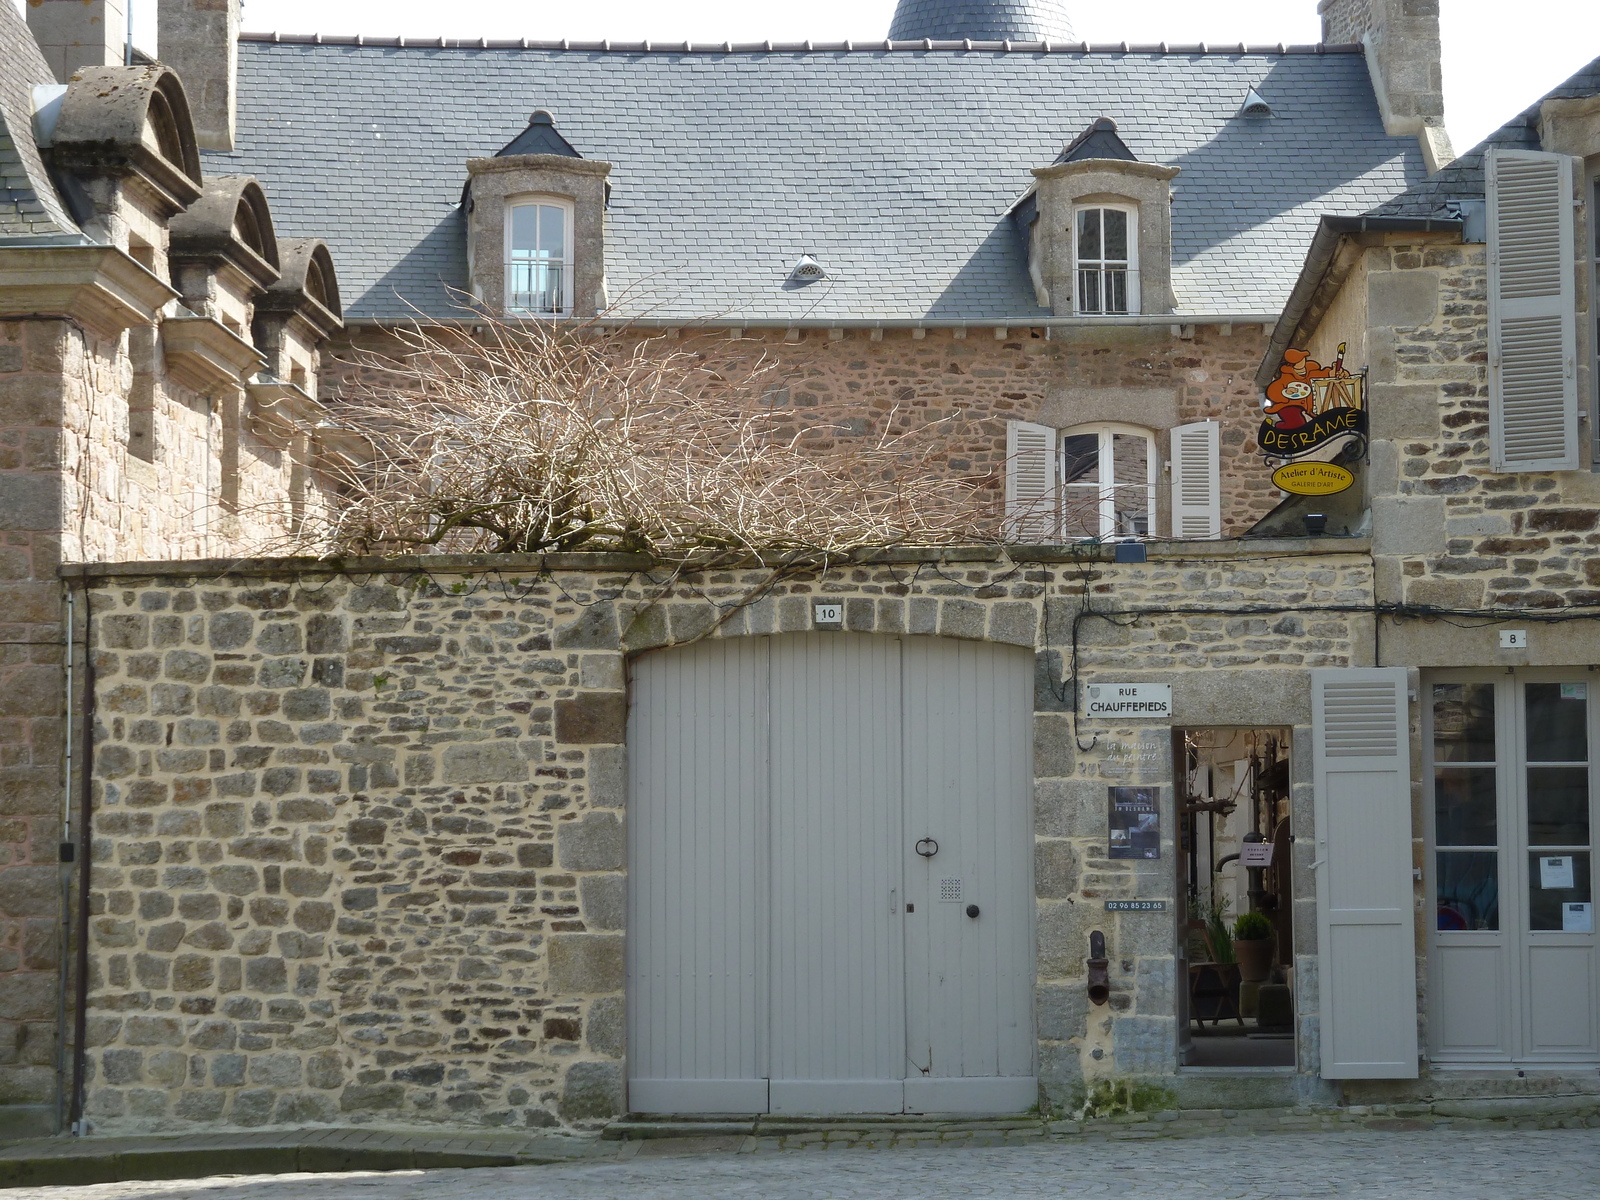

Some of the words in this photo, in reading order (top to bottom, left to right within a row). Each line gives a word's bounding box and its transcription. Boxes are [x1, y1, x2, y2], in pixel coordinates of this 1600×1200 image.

[1280, 468, 1307, 480] Atelier
[1309, 467, 1346, 481] d'Artiste
[822, 609, 835, 618] 10
[1509, 634, 1517, 644] 8
[1119, 688, 1138, 696] RUE
[1090, 702, 1167, 712] CHAUFFEPIEDS
[1121, 742, 1157, 750] maison
[1107, 751, 1119, 761] du
[1122, 752, 1157, 766] peintre
